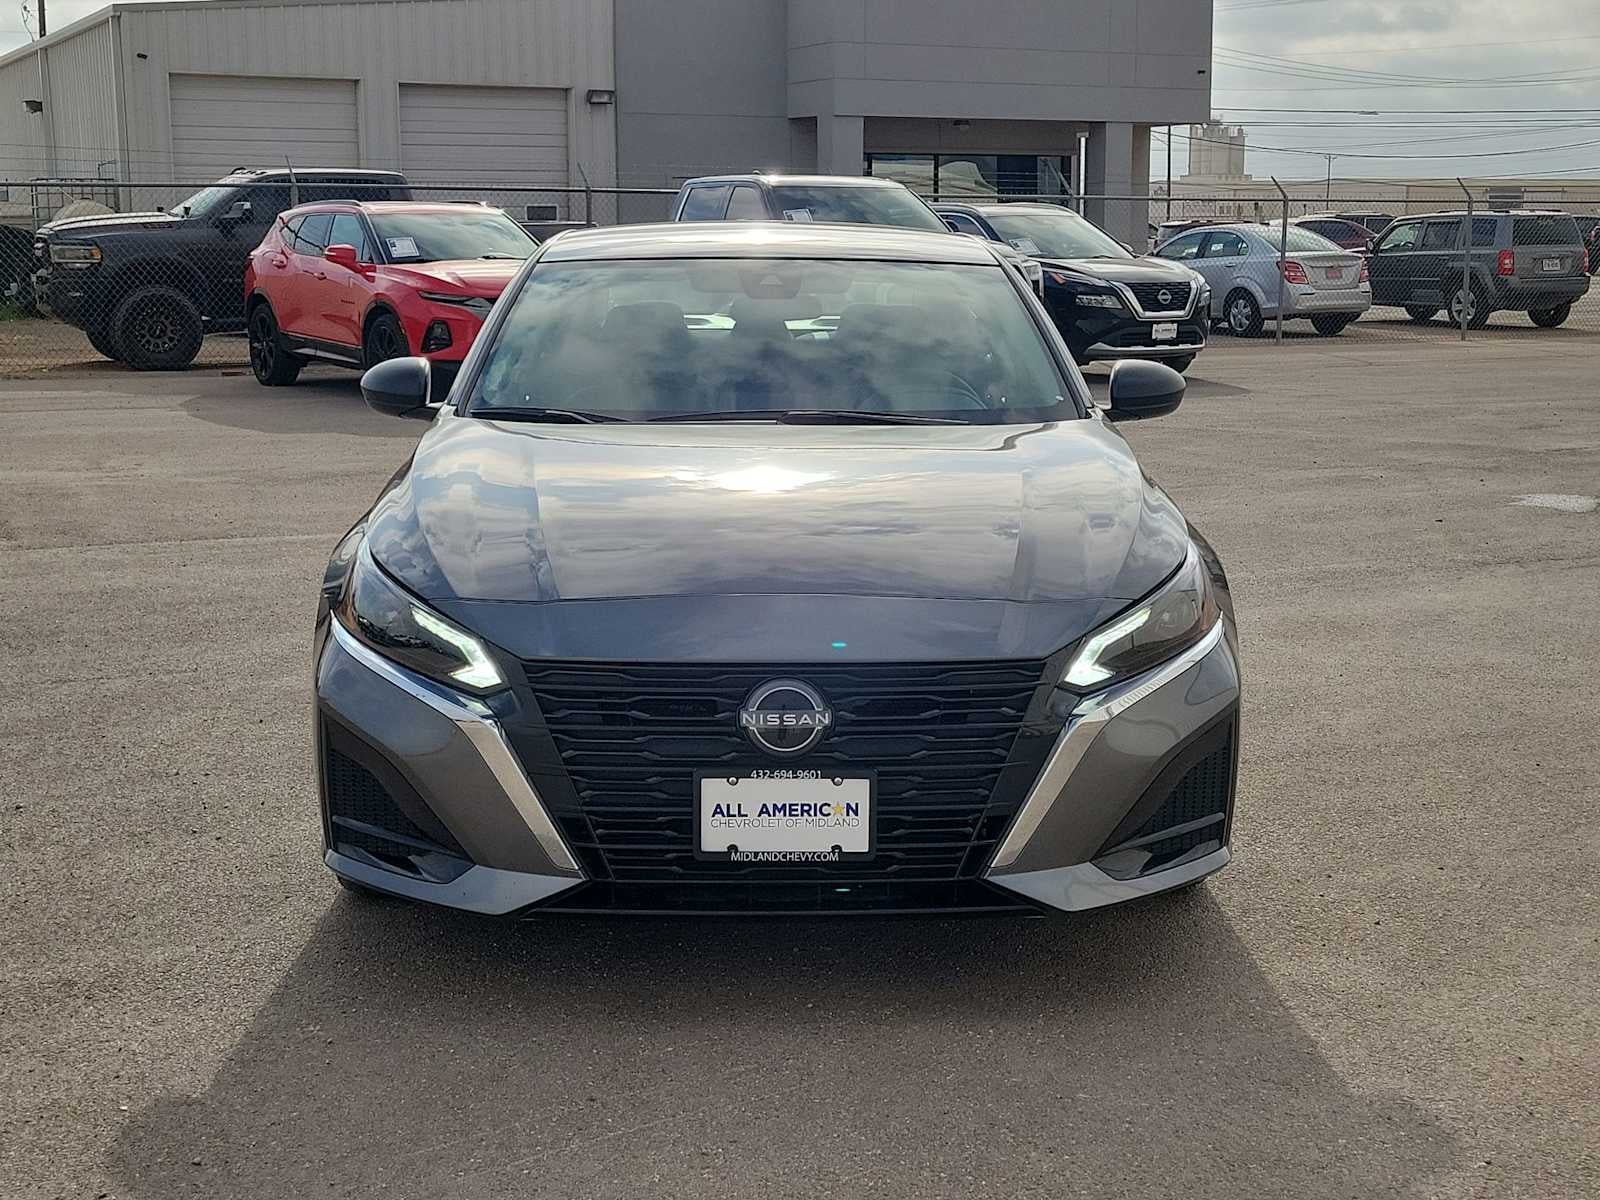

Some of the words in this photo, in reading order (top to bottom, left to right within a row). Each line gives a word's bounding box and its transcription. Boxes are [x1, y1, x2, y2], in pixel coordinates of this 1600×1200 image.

[742, 713, 829, 725] NISSAN
[751, 770, 822, 779] 432-694-9601
[711, 803, 748, 817] ALL
[710, 818, 781, 828] CHEVROLET
[785, 818, 802, 828] OF
[805, 818, 860, 828] MIDLAND
[730, 851, 839, 862] MIDLANDCHEVY.COM
